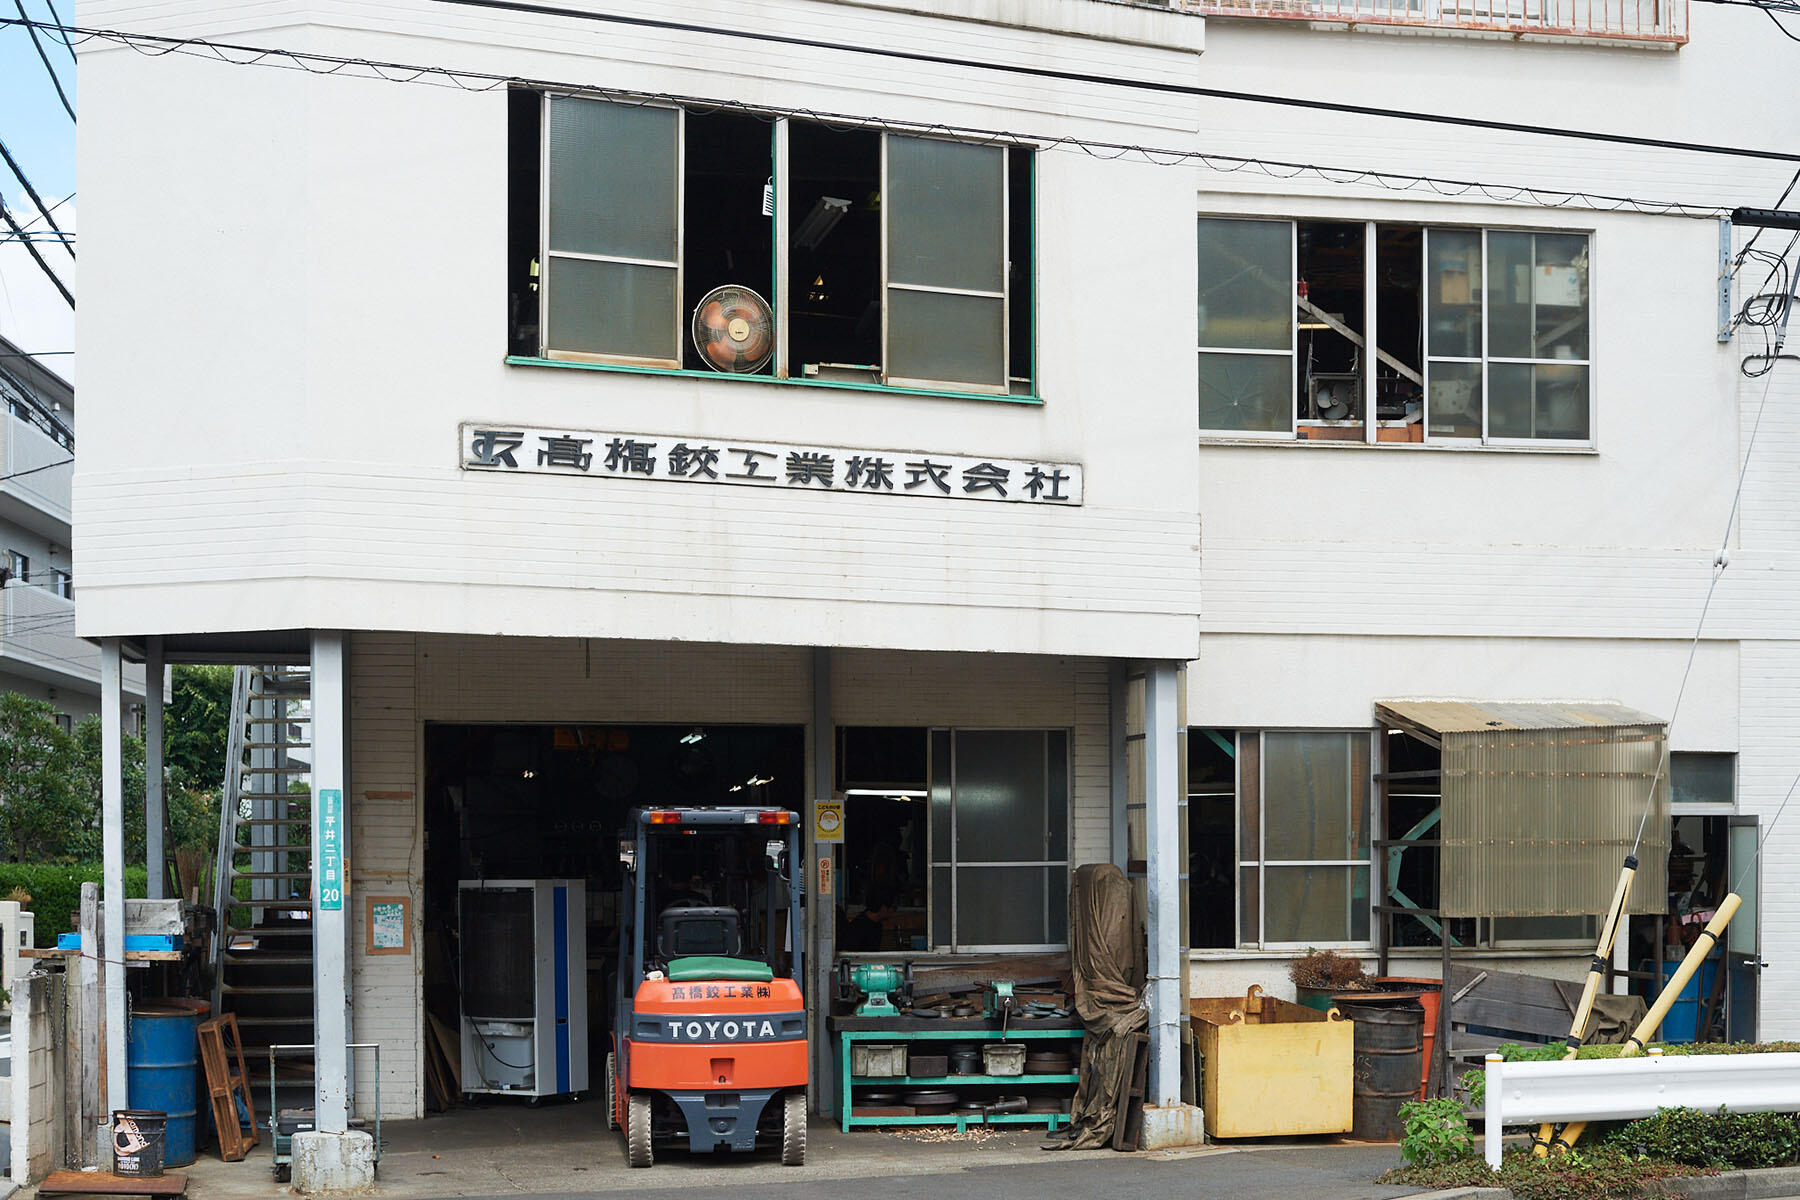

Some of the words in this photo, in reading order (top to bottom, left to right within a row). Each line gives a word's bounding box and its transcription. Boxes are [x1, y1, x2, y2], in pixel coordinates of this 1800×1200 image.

[324, 816, 336, 881] 平井二丁目
[322, 888, 339, 902] 20
[668, 1021, 775, 1038] TOYOTA
